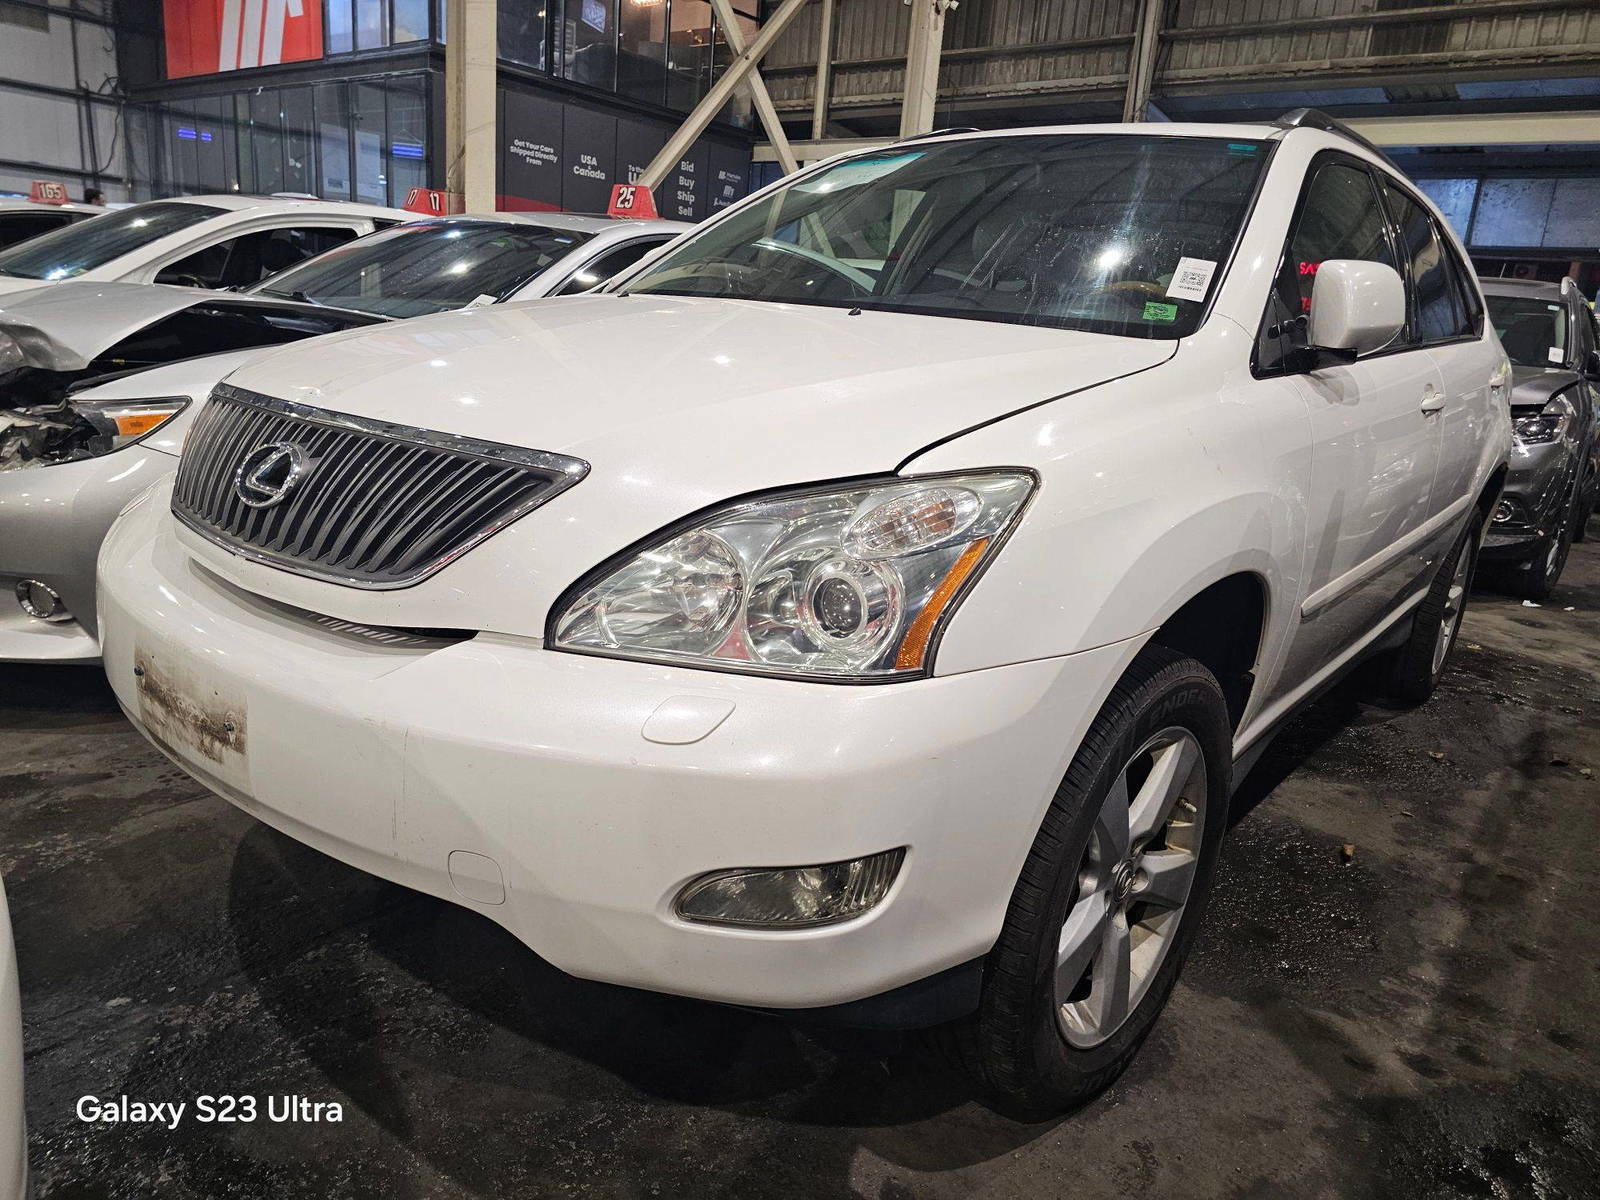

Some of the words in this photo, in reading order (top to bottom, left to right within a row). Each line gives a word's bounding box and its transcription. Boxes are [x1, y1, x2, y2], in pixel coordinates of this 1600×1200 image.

[514, 139, 525, 147] Get
[525, 142, 539, 150] Your
[540, 145, 554, 153] Cars
[510, 145, 534, 157] Shipped
[535, 150, 558, 163] Directly
[581, 154, 598, 166] USA
[526, 157, 542, 166] From
[681, 161, 694, 172] Bid
[573, 165, 605, 180] Canada
[679, 176, 695, 189] Buy
[39, 183, 62, 199] 165
[616, 187, 636, 208] 25
[677, 190, 695, 205] Ship
[429, 192, 440, 211] 17
[678, 206, 693, 216] Sell
